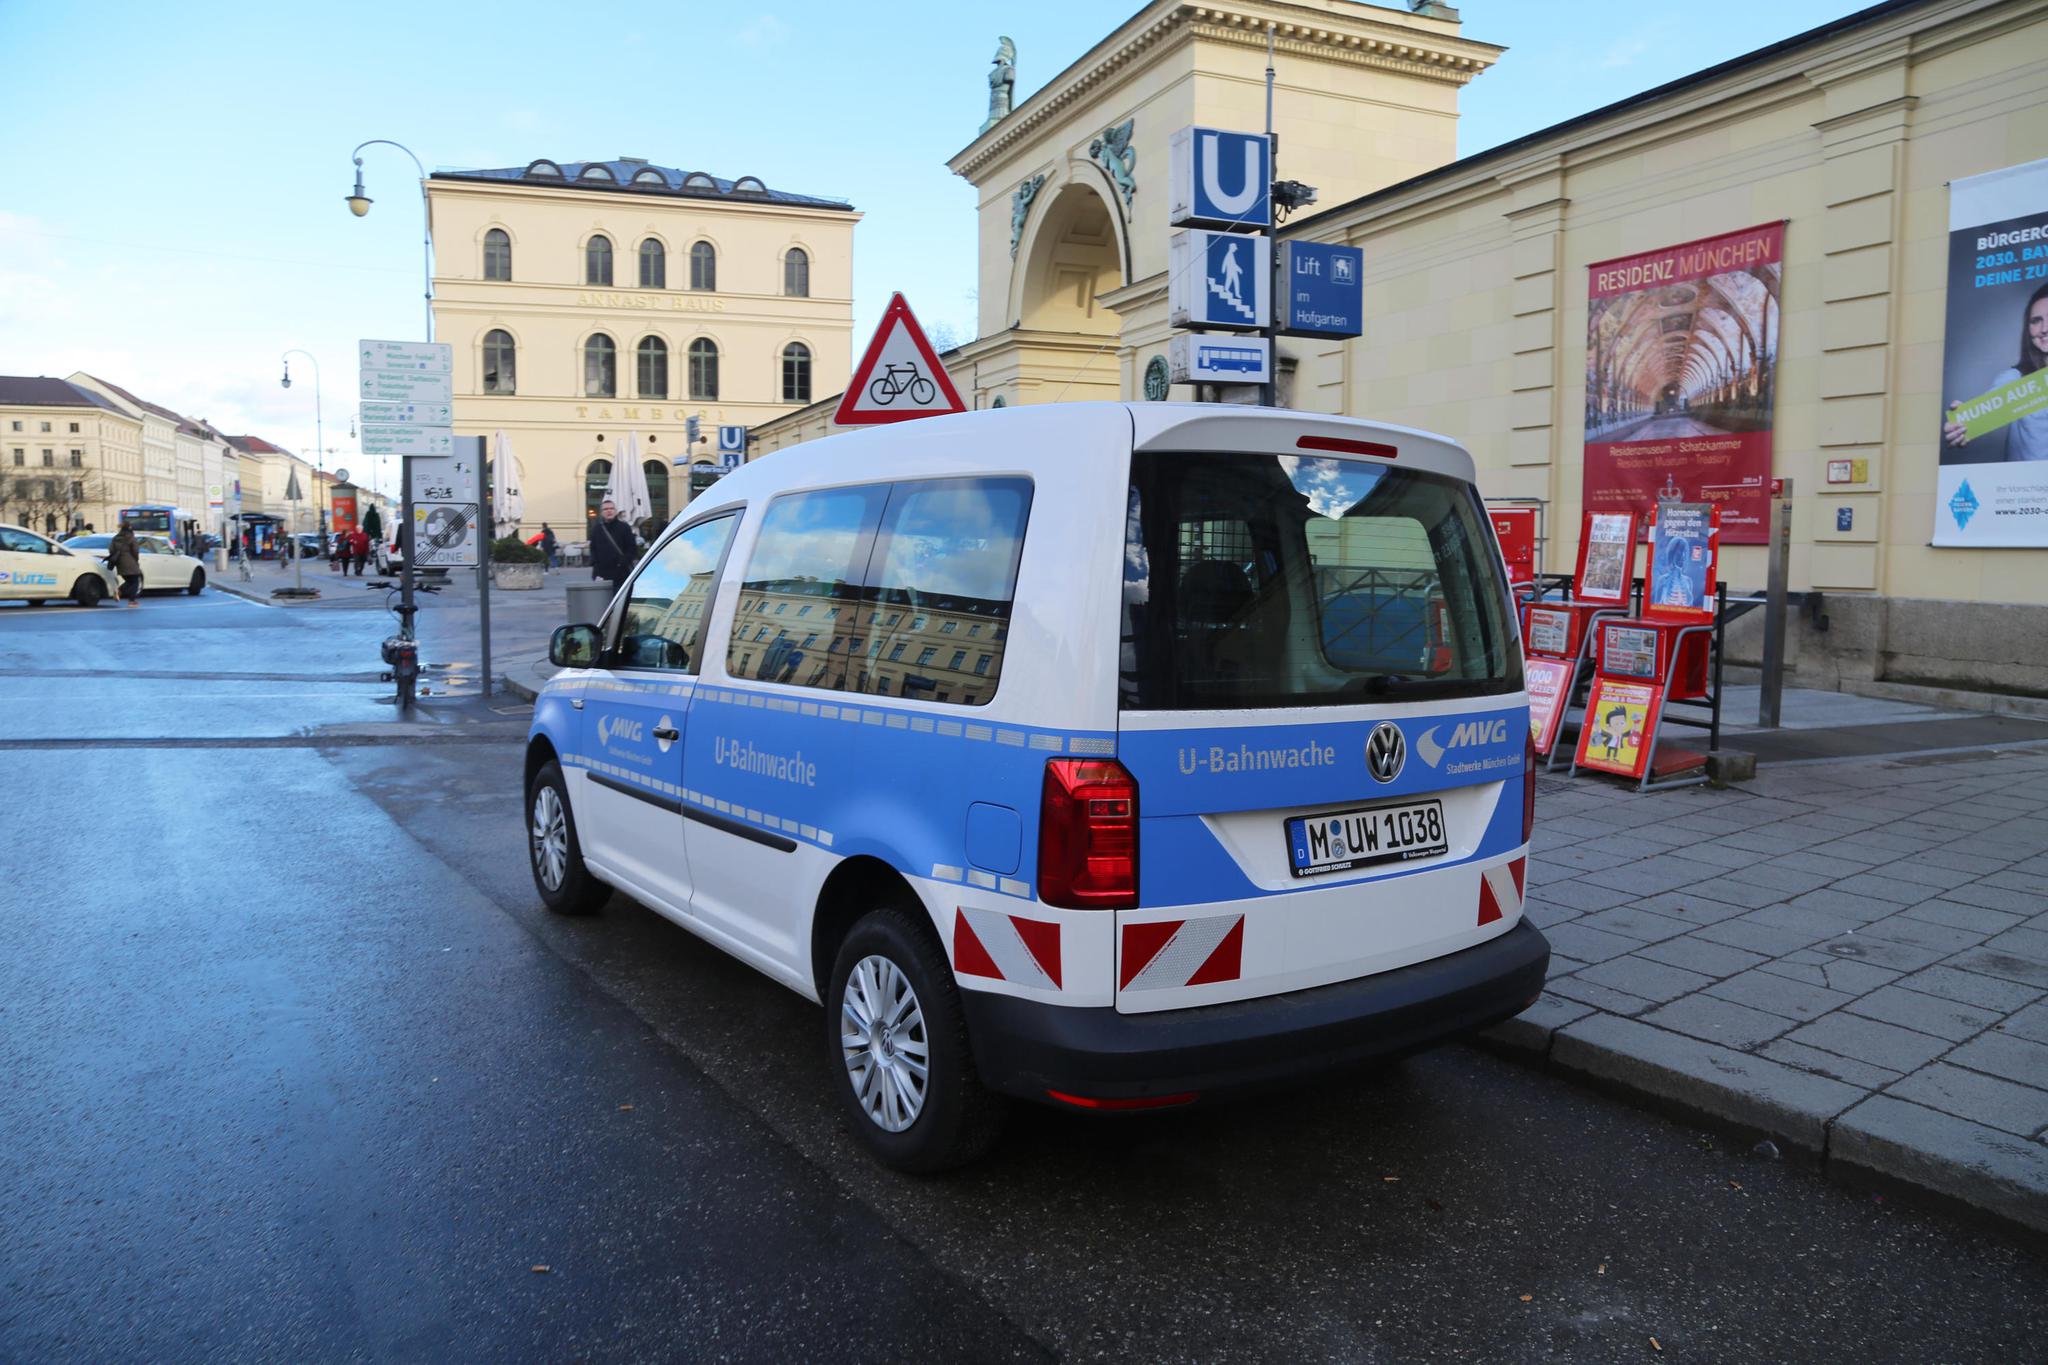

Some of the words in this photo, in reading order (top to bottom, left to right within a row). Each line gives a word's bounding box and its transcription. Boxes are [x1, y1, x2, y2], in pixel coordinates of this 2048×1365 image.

[1202, 135, 1260, 215] U
[1296, 255, 1321, 277] Lift
[1598, 259, 1674, 292] RESIDENZ
[1679, 237, 1771, 278] MÜNCHEN
[1976, 251, 2018, 270] 2030.
[1975, 268, 2022, 288] DEINE
[576, 292, 661, 311] ANNAST
[671, 297, 726, 313] HAUS
[1296, 292, 1310, 303] im
[1296, 309, 1348, 328] Hofgarten
[1956, 396, 2004, 424] MUND
[721, 427, 742, 449] U
[1609, 444, 1672, 457] Residenzmuseum
[1679, 439, 1742, 452] Schatzkammer
[1655, 456, 1688, 467] Museum
[1696, 454, 1732, 466] Treasury
[1701, 489, 1730, 501] Eingang
[1736, 488, 1761, 498] Tickets
[1667, 508, 1701, 517] Hormone
[1664, 519, 1686, 529] gegen
[1687, 518, 1702, 527] den
[1665, 529, 1700, 538] Hitzestau
[431, 552, 463, 563] ZONE
[610, 716, 643, 742] MVG
[1448, 719, 1507, 749] MVG
[715, 735, 817, 787] U-Bahnwache
[1178, 740, 1335, 775] U-Bahnwache
[1446, 760, 1482, 775] Stadtwerke
[1483, 758, 1507, 770] München
[1309, 822, 1330, 861] M
[1345, 815, 1379, 854] UW
[1384, 807, 1442, 849] 1038
[1298, 848, 1305, 860] D
